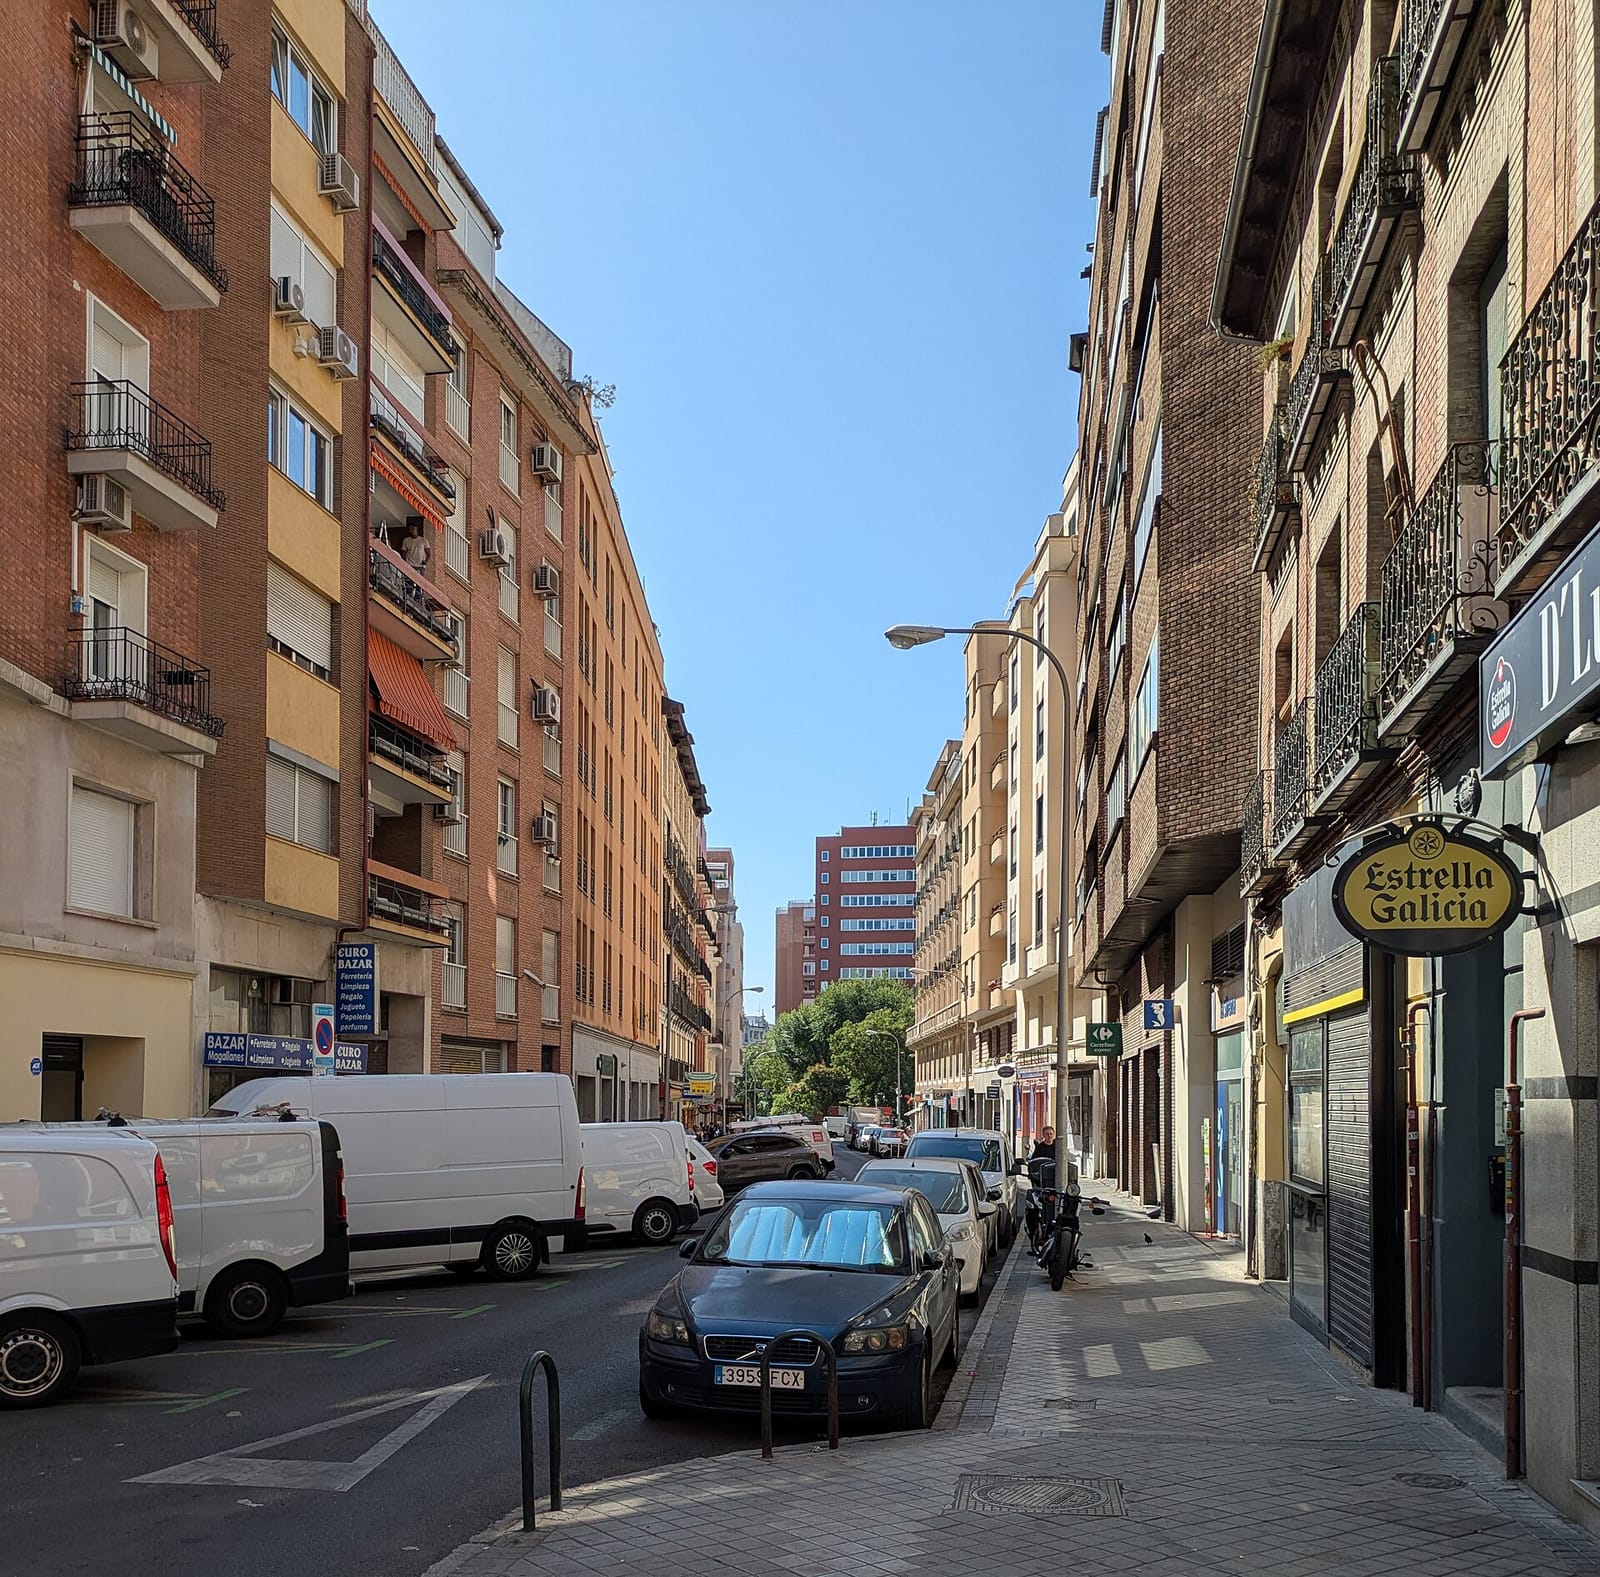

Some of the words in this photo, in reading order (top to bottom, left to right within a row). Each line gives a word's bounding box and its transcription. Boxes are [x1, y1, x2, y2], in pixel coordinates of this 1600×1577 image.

[1491, 679, 1511, 711] Estrella
[1491, 700, 1511, 730] Galicia
[1363, 861, 1495, 892] Estrella
[1370, 891, 1488, 924] Galicia
[338, 959, 373, 969] BAZAR
[340, 983, 370, 991] Limpieza
[340, 993, 364, 1001] Regalo
[340, 1003, 366, 1011] Juguete
[340, 1023, 369, 1032] perfume
[207, 1035, 245, 1051] BAZAR
[284, 1041, 301, 1054] Regalo
[207, 1050, 245, 1063] Magallanes
[252, 1053, 275, 1066] Limpieza
[283, 1057, 302, 1068] Juguete
[335, 1058, 362, 1070] BAZAR
[770, 1370, 801, 1387] FCX
